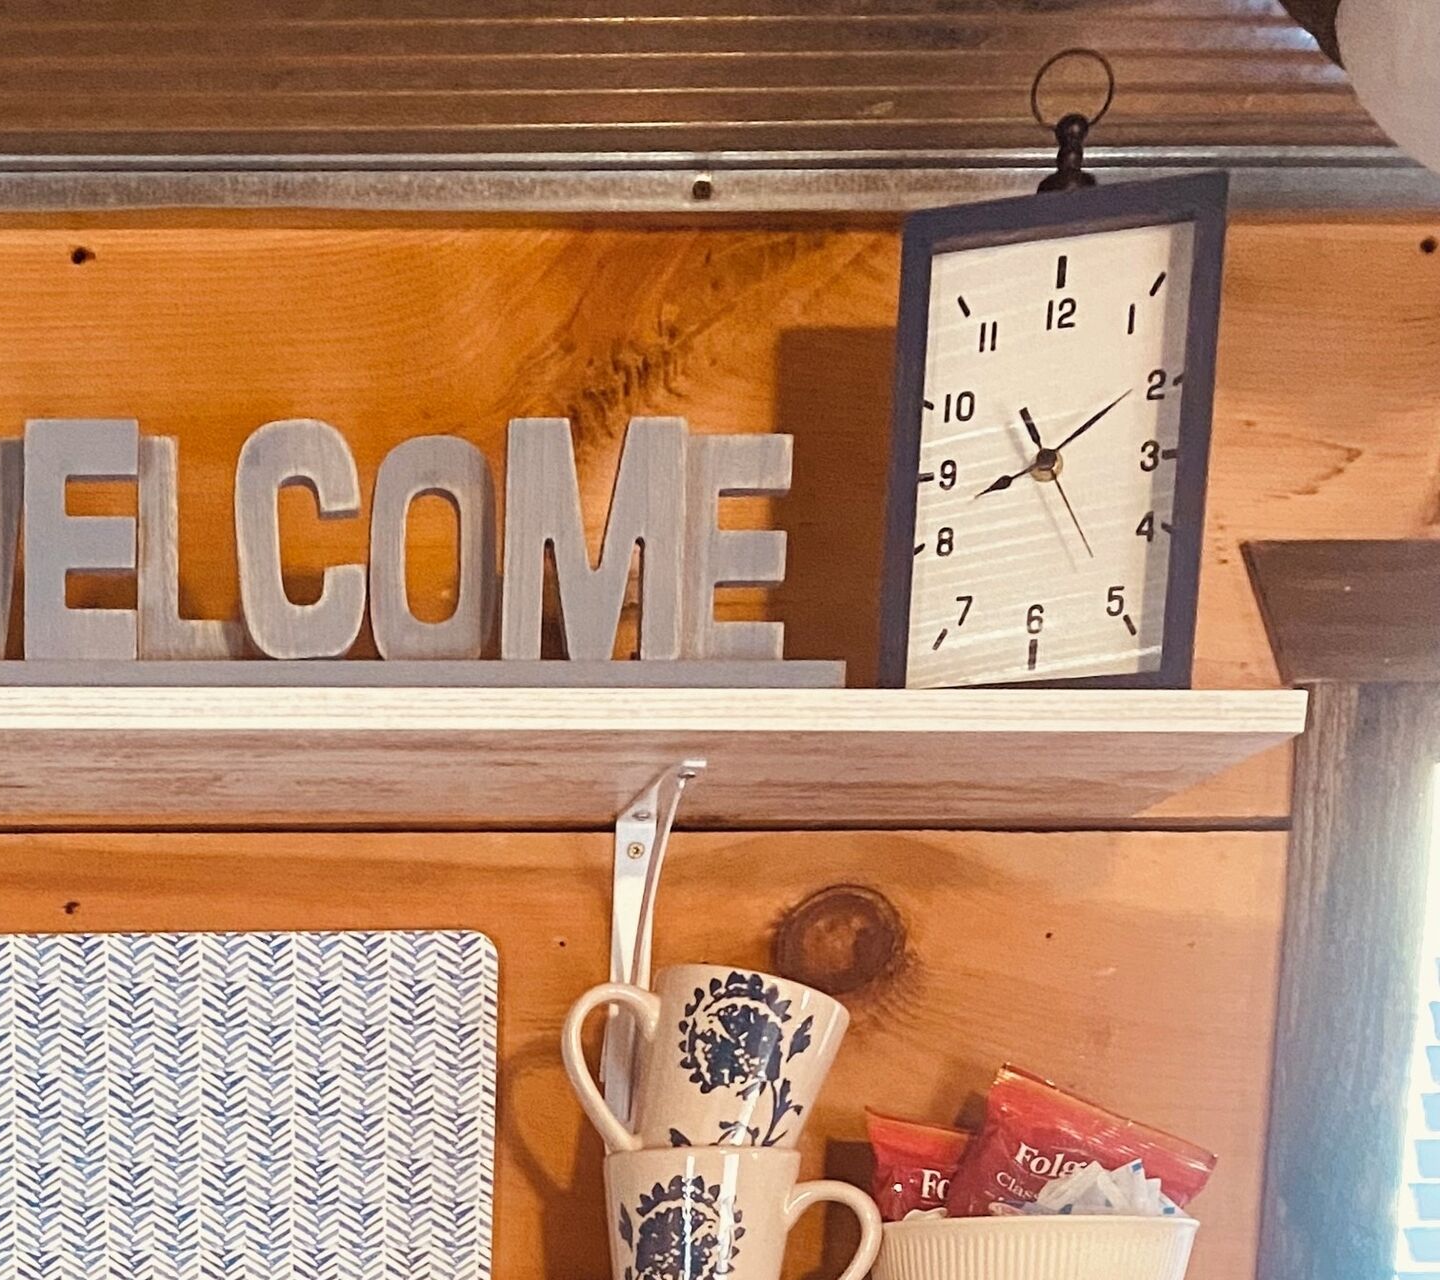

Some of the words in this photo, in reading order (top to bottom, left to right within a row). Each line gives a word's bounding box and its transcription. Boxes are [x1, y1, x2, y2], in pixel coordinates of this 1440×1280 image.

[1046, 298, 1077, 330] 12
[1127, 303, 1136, 335] 1
[978, 321, 998, 353] 11
[1146, 368, 1166, 401] 2
[943, 391, 976, 423] 10
[1140, 440, 1160, 470] 3
[939, 460, 958, 491] 9
[935, 526, 955, 557] 8
[1136, 511, 1155, 542] 4
[956, 595, 974, 626] 7
[1106, 586, 1125, 617] 5
[1026, 603, 1044, 634] 6
